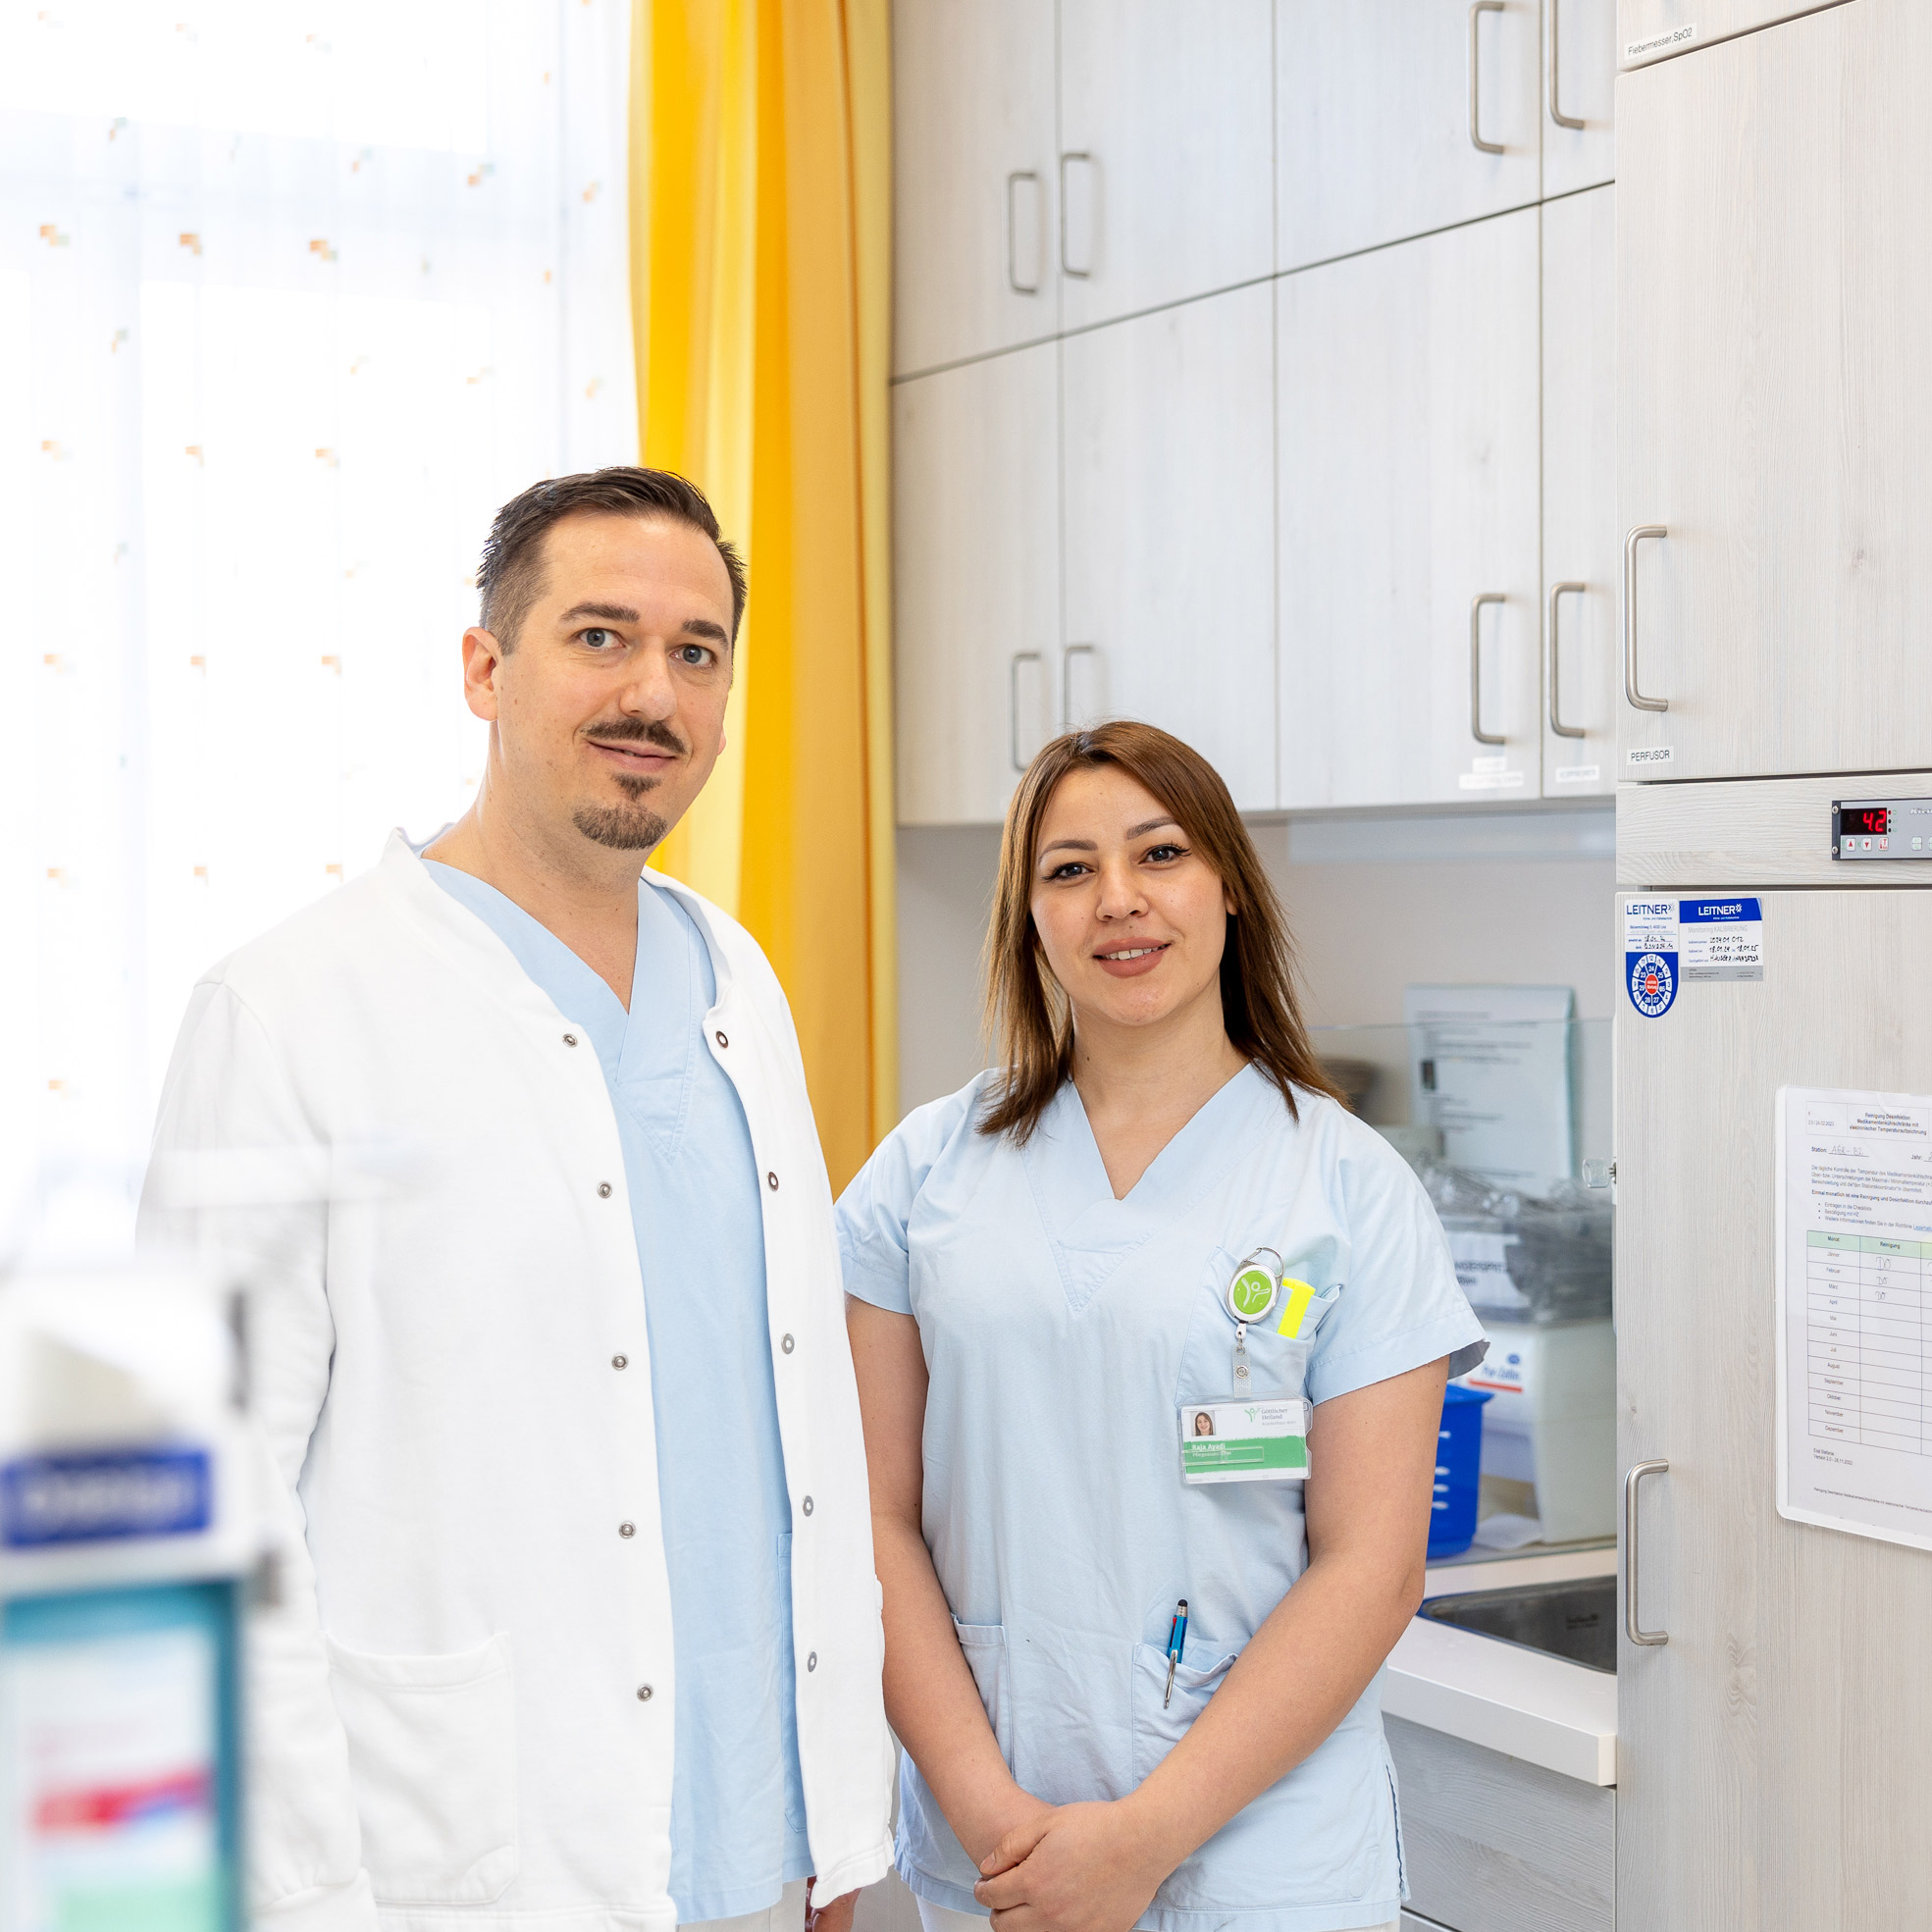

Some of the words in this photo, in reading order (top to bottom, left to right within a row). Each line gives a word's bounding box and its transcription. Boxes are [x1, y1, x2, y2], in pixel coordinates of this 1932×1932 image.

[1631, 750, 1670, 761] PERFUSOR
[1626, 904, 1668, 915] LEITNER
[1698, 905, 1736, 916] LEITNER
[1880, 1241, 1900, 1249] Reinigung
